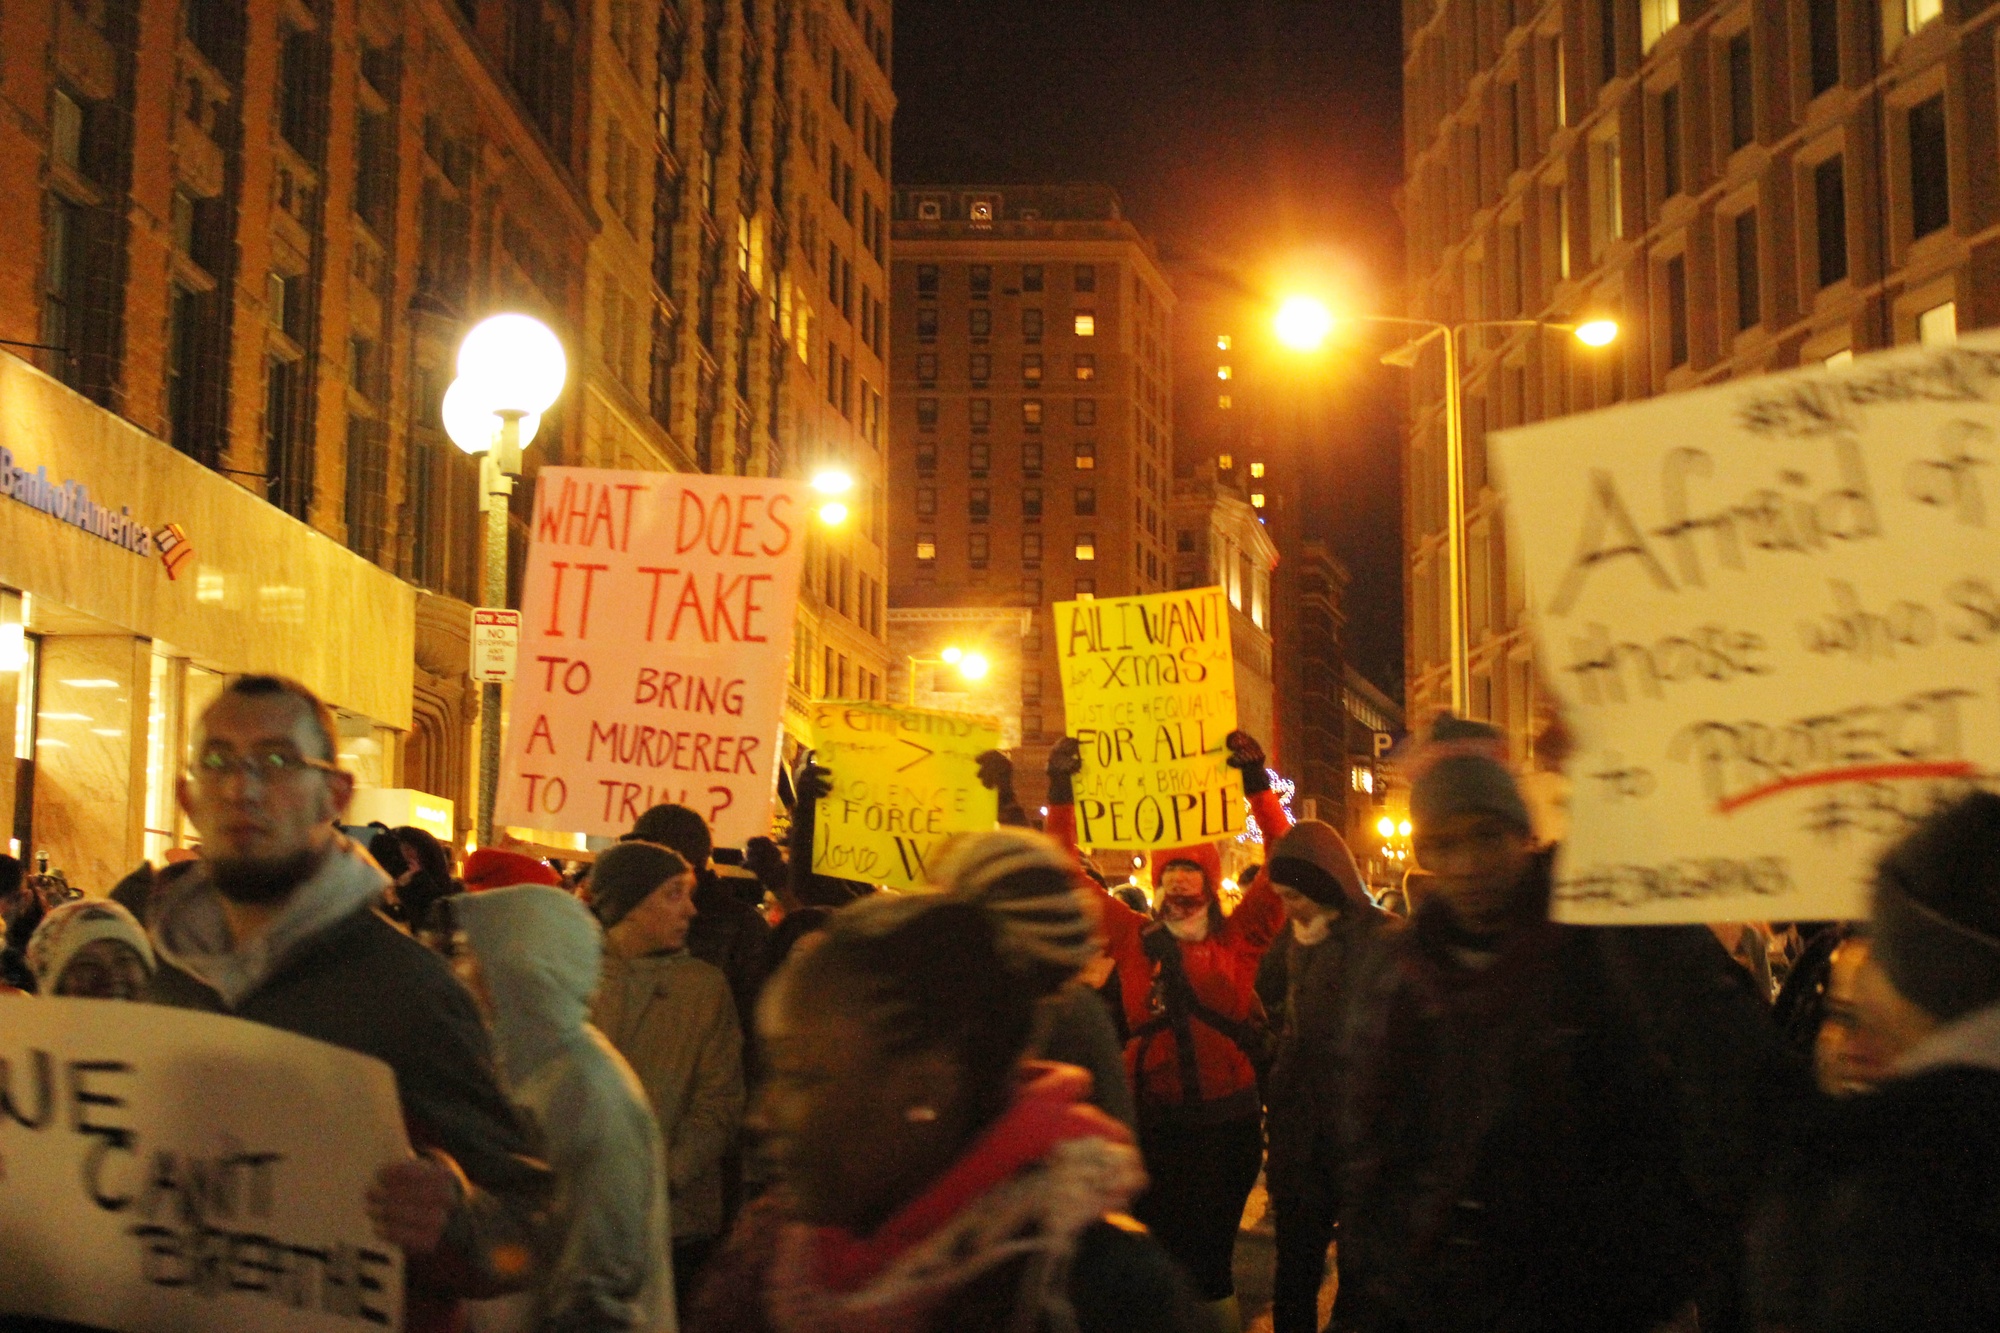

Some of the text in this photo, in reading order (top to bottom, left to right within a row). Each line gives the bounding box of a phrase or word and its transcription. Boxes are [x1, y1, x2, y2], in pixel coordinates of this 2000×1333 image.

[537, 474, 793, 557] WHAT DOES
[1545, 437, 1883, 616] Afraid
[476, 613, 517, 625] TOW ZONE
[542, 561, 772, 642] IT TAKE
[1115, 603, 1133, 650] I
[1134, 592, 1225, 648] WANT
[487, 629, 505, 639] NO
[536, 655, 745, 716] TO BRING
[525, 714, 761, 776] A MURDERER
[1077, 719, 1223, 768] FOR ALL
[1373, 733, 1393, 758] P
[521, 773, 567, 814] TO
[1075, 772, 1127, 797] BLACK
[1157, 765, 1229, 793] BROWN
[843, 800, 943, 834] FORCE
[1079, 783, 1243, 843] PEOPLE
[814, 823, 892, 879] love
